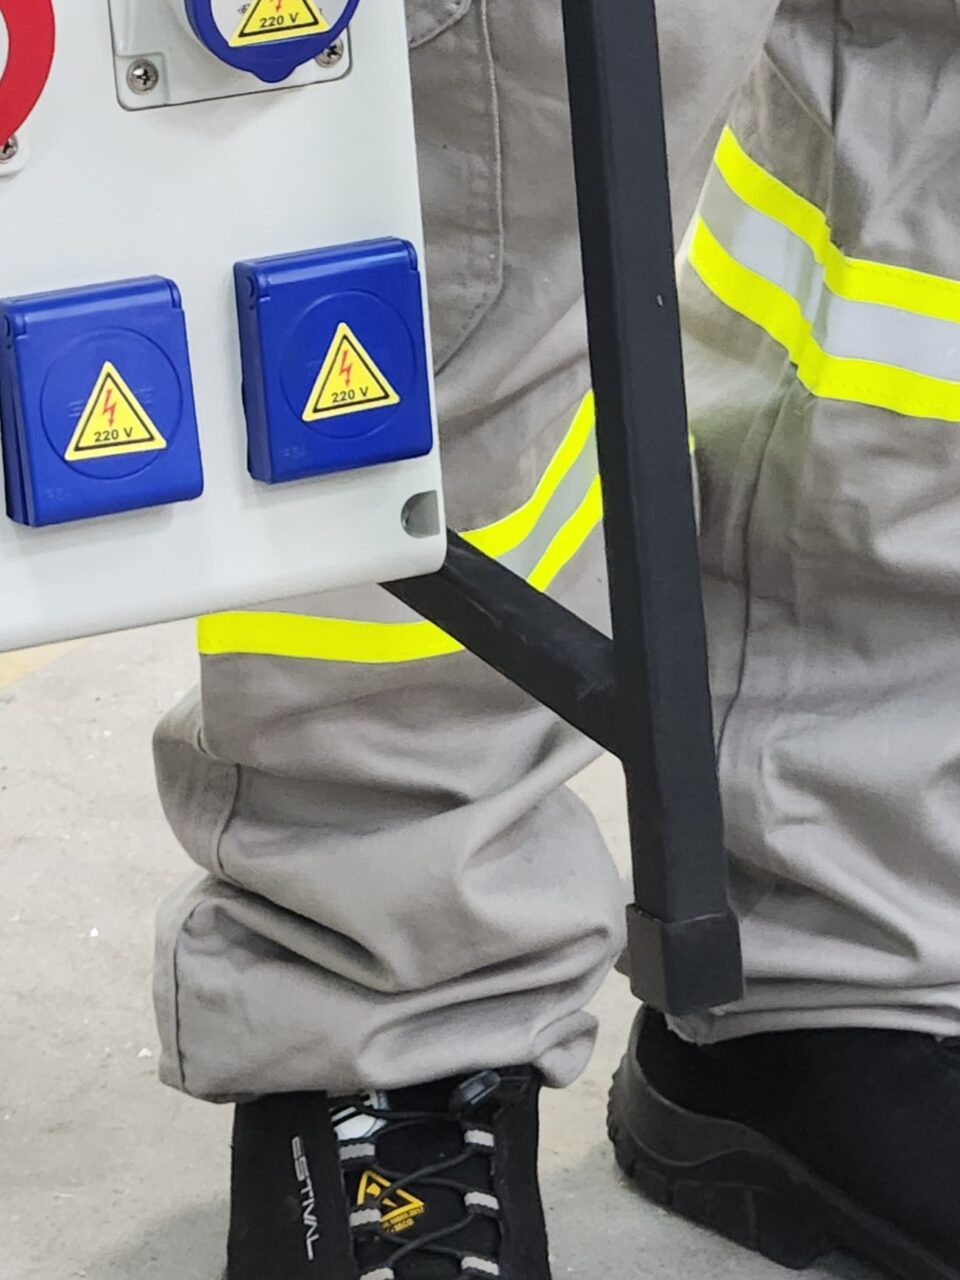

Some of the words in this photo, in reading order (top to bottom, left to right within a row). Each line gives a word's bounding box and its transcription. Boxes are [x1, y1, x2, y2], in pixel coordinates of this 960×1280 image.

[259, 15, 284, 28] 220
[290, 12, 299, 23] V
[331, 389, 356, 403] 220
[360, 386, 369, 397] V
[94, 428, 119, 442] 220
[124, 427, 133, 438] V
[291, 1136, 320, 1261] ESTIVAL
